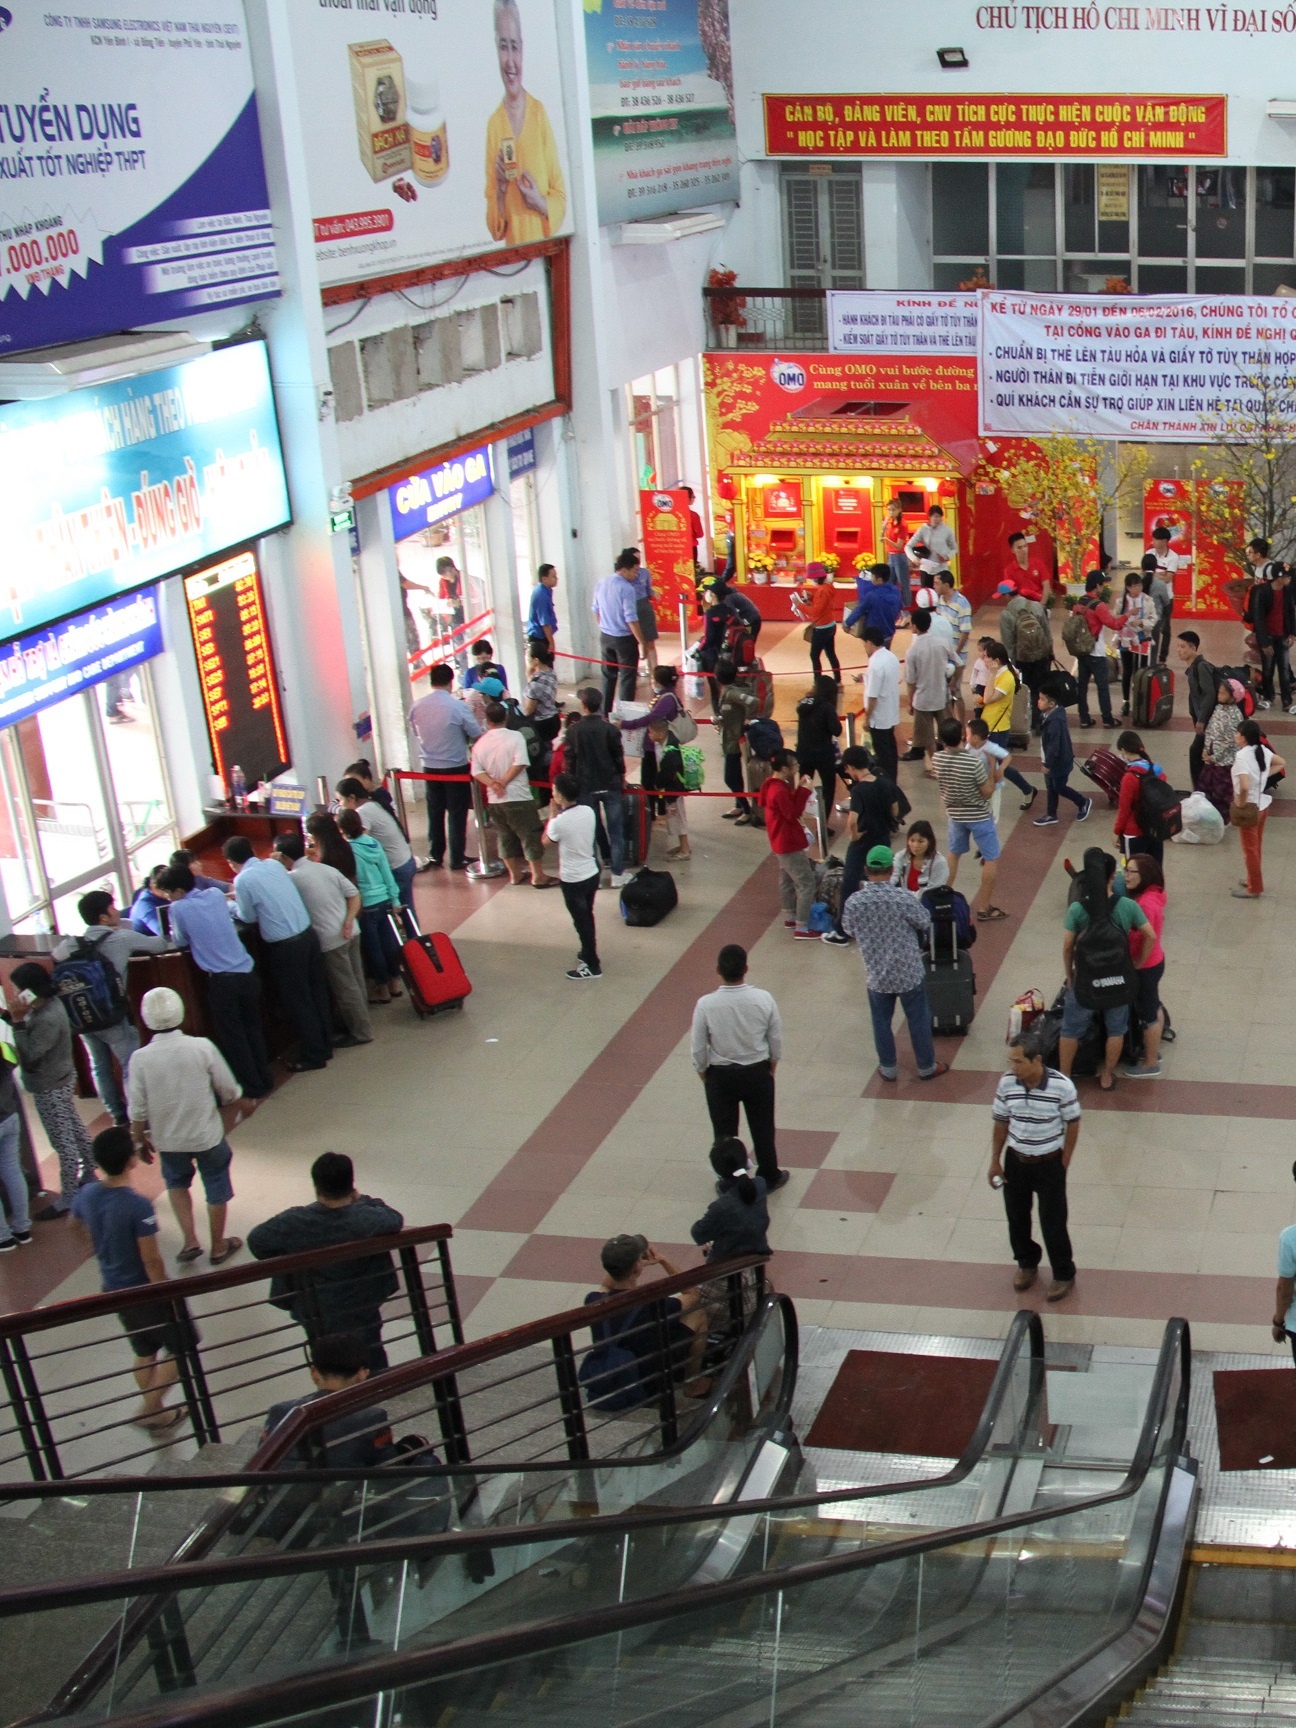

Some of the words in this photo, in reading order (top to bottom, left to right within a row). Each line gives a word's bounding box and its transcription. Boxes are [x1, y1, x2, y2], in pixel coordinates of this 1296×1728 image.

[1021, 6, 1068, 34] TỊCH
[1144, 8, 1201, 31] MINH
[1206, 3, 1228, 31] VĨ
[1232, 9, 1267, 37] ĐẠI
[844, 101, 880, 122] ĐẢNG
[885, 103, 921, 124] VIÊN,
[925, 105, 951, 122] CNV
[957, 101, 986, 122] TÍCH
[990, 103, 1017, 125] CỰC
[1021, 103, 1055, 126] THỰC
[1059, 102, 1091, 126] HIỆN
[1095, 103, 1131, 126] CUỘC
[1136, 103, 1164, 126] VẬN
[1169, 103, 1206, 127] ĐỘNG
[76, 103, 142, 150] DỤNG
[798, 131, 824, 150] HỌC
[828, 128, 854, 150] TẬP
[858, 128, 877, 147] VÀ
[881, 128, 911, 147] LÀM
[915, 131, 949, 147] THEO
[954, 126, 984, 147] TẤM
[988, 129, 1032, 147] GƯƠNG
[1036, 131, 1065, 150] ĐẠO
[1070, 128, 1097, 147] ĐỨC
[1101, 126, 1119, 148] HỒ
[1123, 129, 1145, 147] CHÍ
[1150, 131, 1184, 148] MINH
[115, 150, 146, 171] THPT
[0, 229, 79, 276] .000.000
[896, 299, 932, 308] KÍNH
[1068, 305, 1098, 318] 29/01
[1044, 325, 1064, 340] TẠI
[1068, 320, 1101, 338] CỔNG
[1106, 323, 1130, 338] VÀO
[1134, 326, 1150, 338] GA
[1155, 326, 1167, 339] ĐI
[1171, 323, 1198, 340] TÀU,
[1202, 323, 1232, 339] KÍNH
[1236, 322, 1251, 340] ĐỀ
[779, 372, 805, 386] OMO
[809, 363, 842, 377] Cùng
[845, 364, 876, 375] OMO
[879, 365, 899, 375] vui
[902, 364, 932, 376] bước
[935, 365, 974, 378] đường
[431, 461, 465, 497] VÀO
[465, 454, 487, 483] GA
